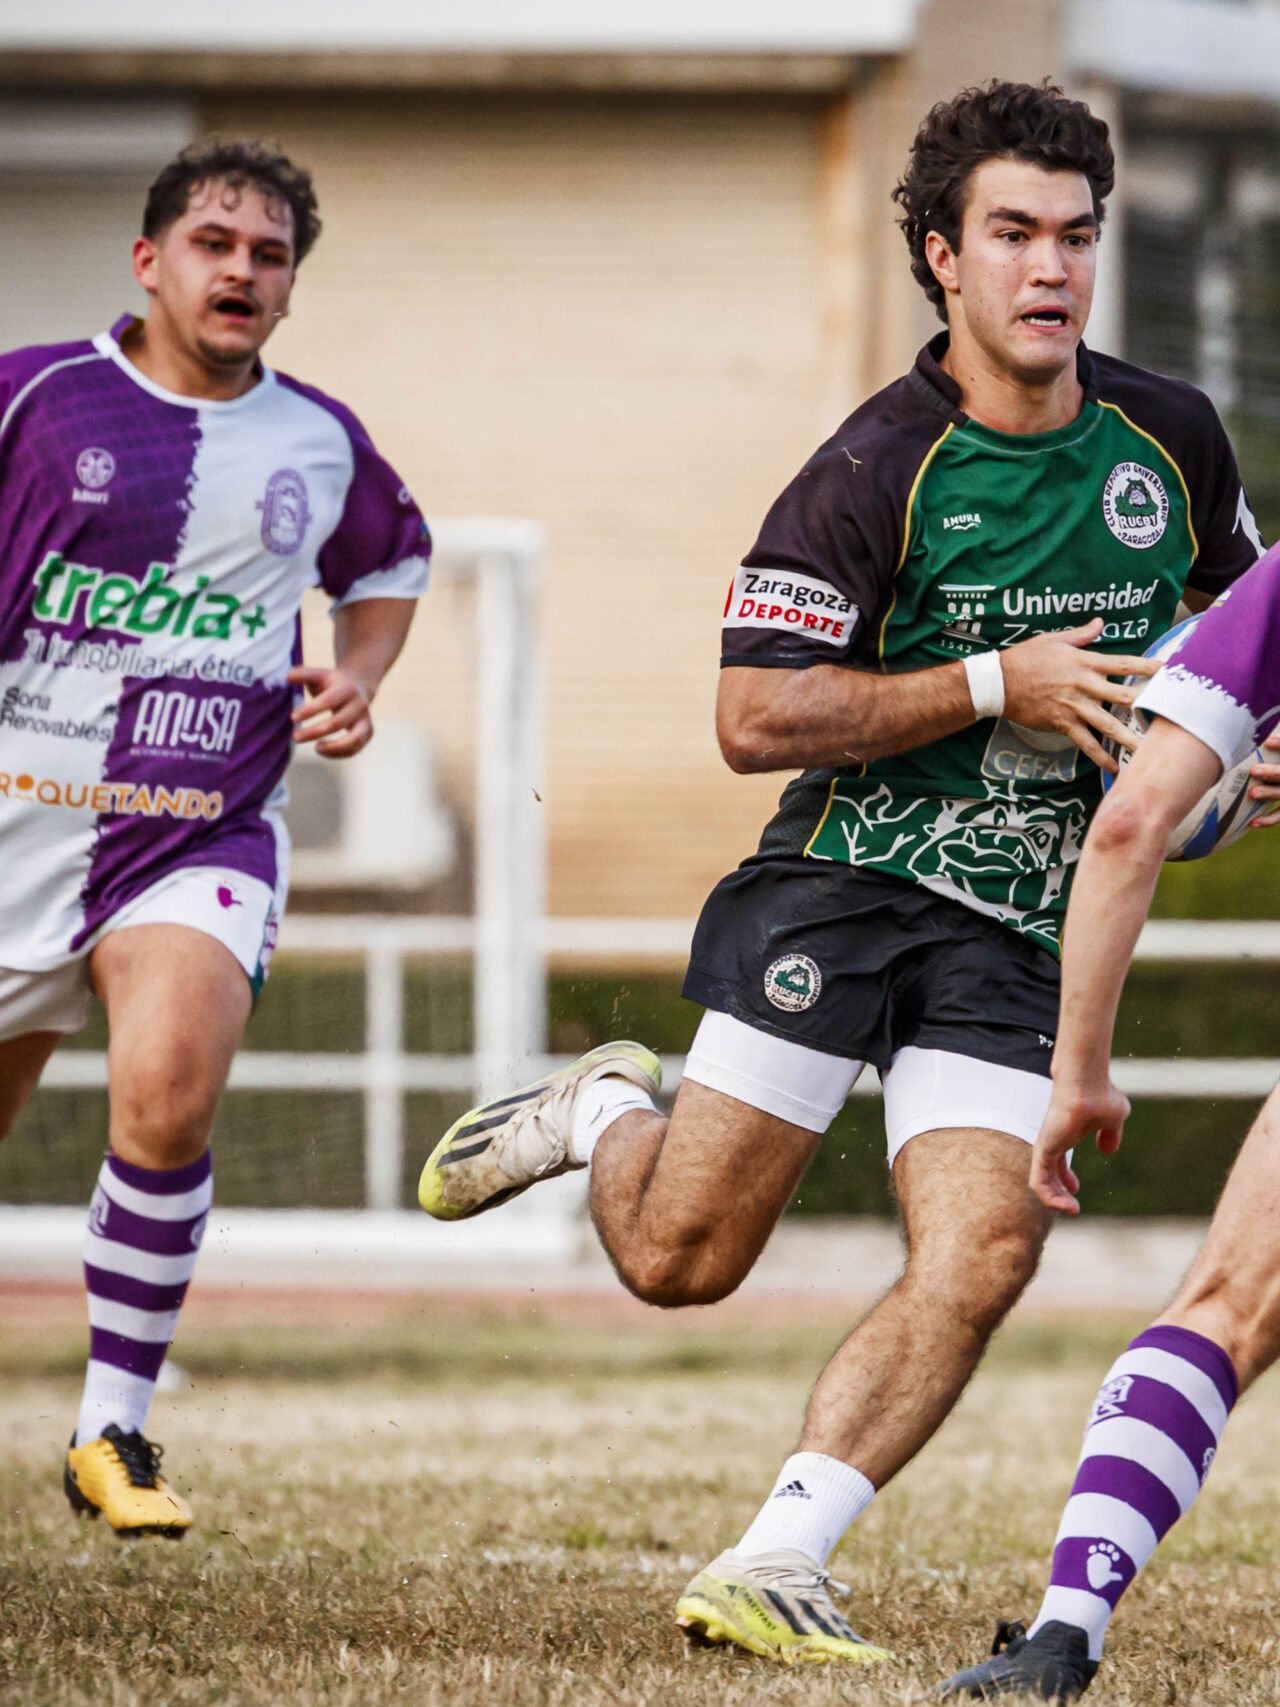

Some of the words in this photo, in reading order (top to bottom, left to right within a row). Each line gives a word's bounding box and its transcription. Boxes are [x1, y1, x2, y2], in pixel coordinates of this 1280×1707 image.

[943, 513, 981, 530] AMURA
[1104, 500, 1115, 527] CLUB
[1119, 513, 1158, 529] RUGBY
[1122, 530, 1161, 545] ZARAGOZA
[744, 573, 853, 614] Zaragoza
[1002, 579, 1160, 616] Universidad
[737, 599, 845, 638] DEPORTE
[1000, 618, 1149, 646] Zoza
[941, 639, 972, 654] 1542
[201, 654, 254, 685] ética
[0, 706, 113, 743] Renovables
[994, 750, 1062, 781] CEFA
[772, 983, 807, 1003] RUGBY
